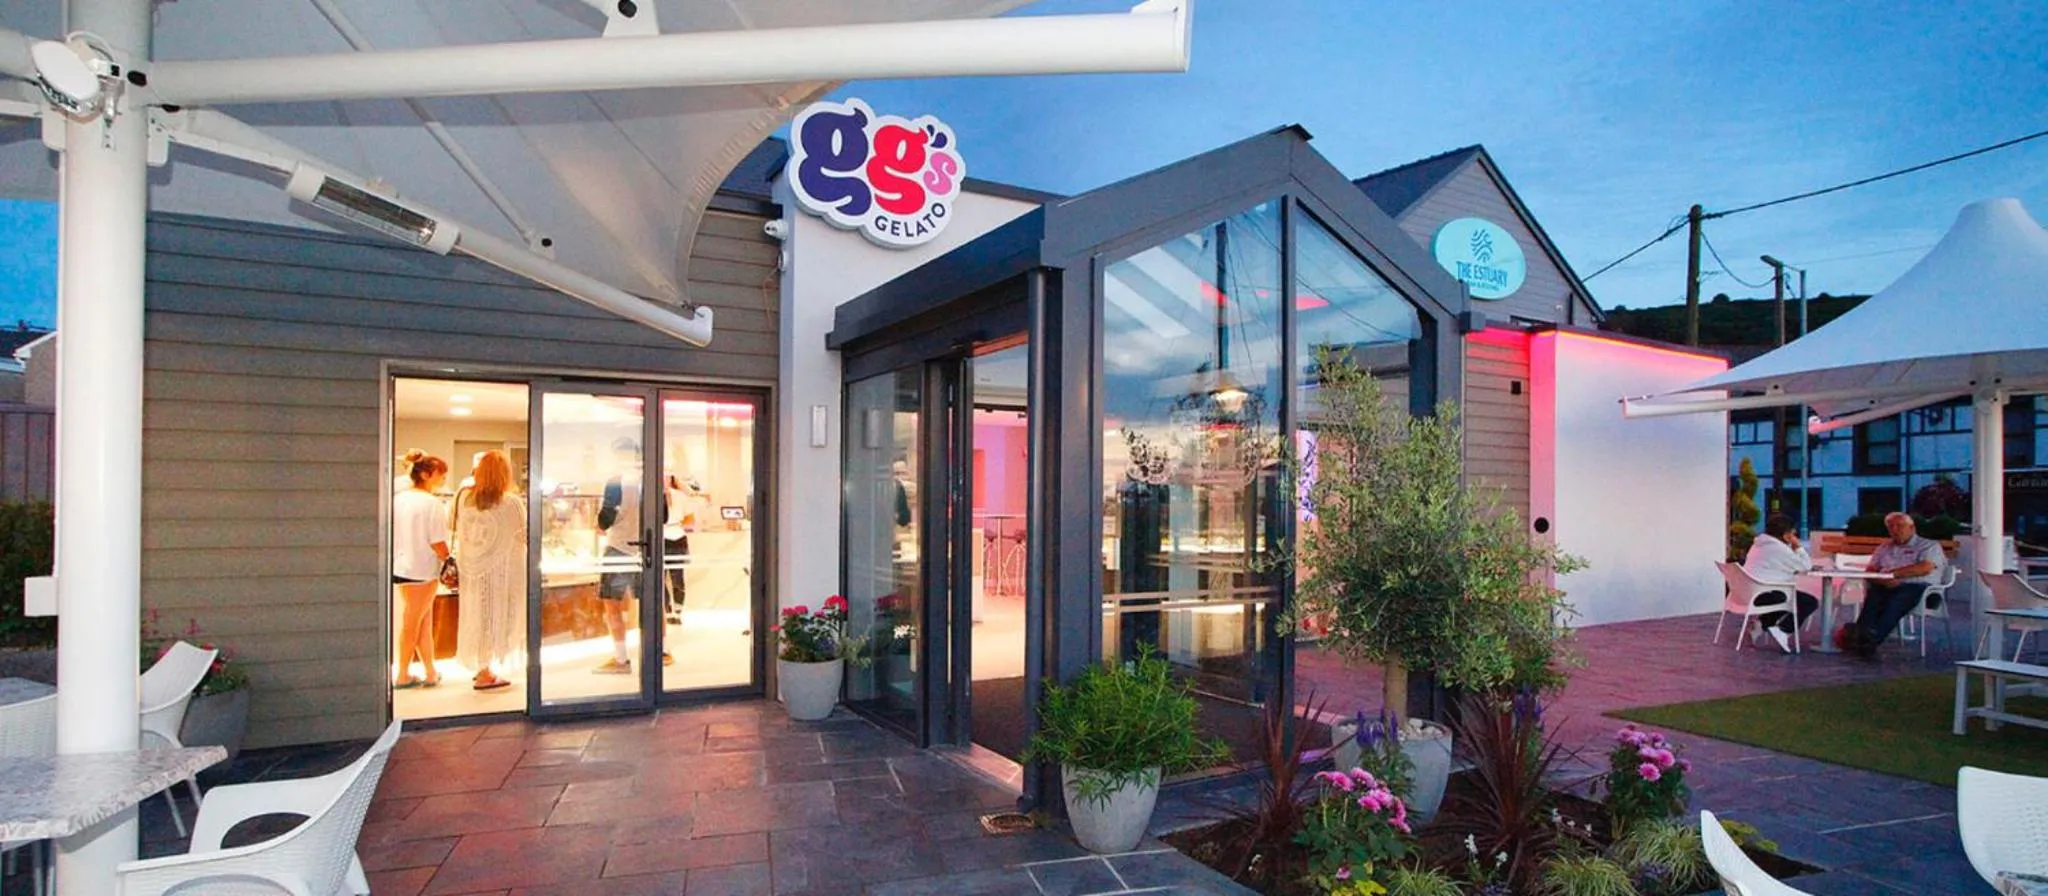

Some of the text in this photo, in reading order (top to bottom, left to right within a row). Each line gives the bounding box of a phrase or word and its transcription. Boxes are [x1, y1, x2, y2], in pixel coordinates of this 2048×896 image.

[798, 108, 957, 216] gg's
[874, 203, 946, 237] GELATO
[1456, 261, 1471, 279] THE
[1473, 264, 1508, 288] ESTUARY
